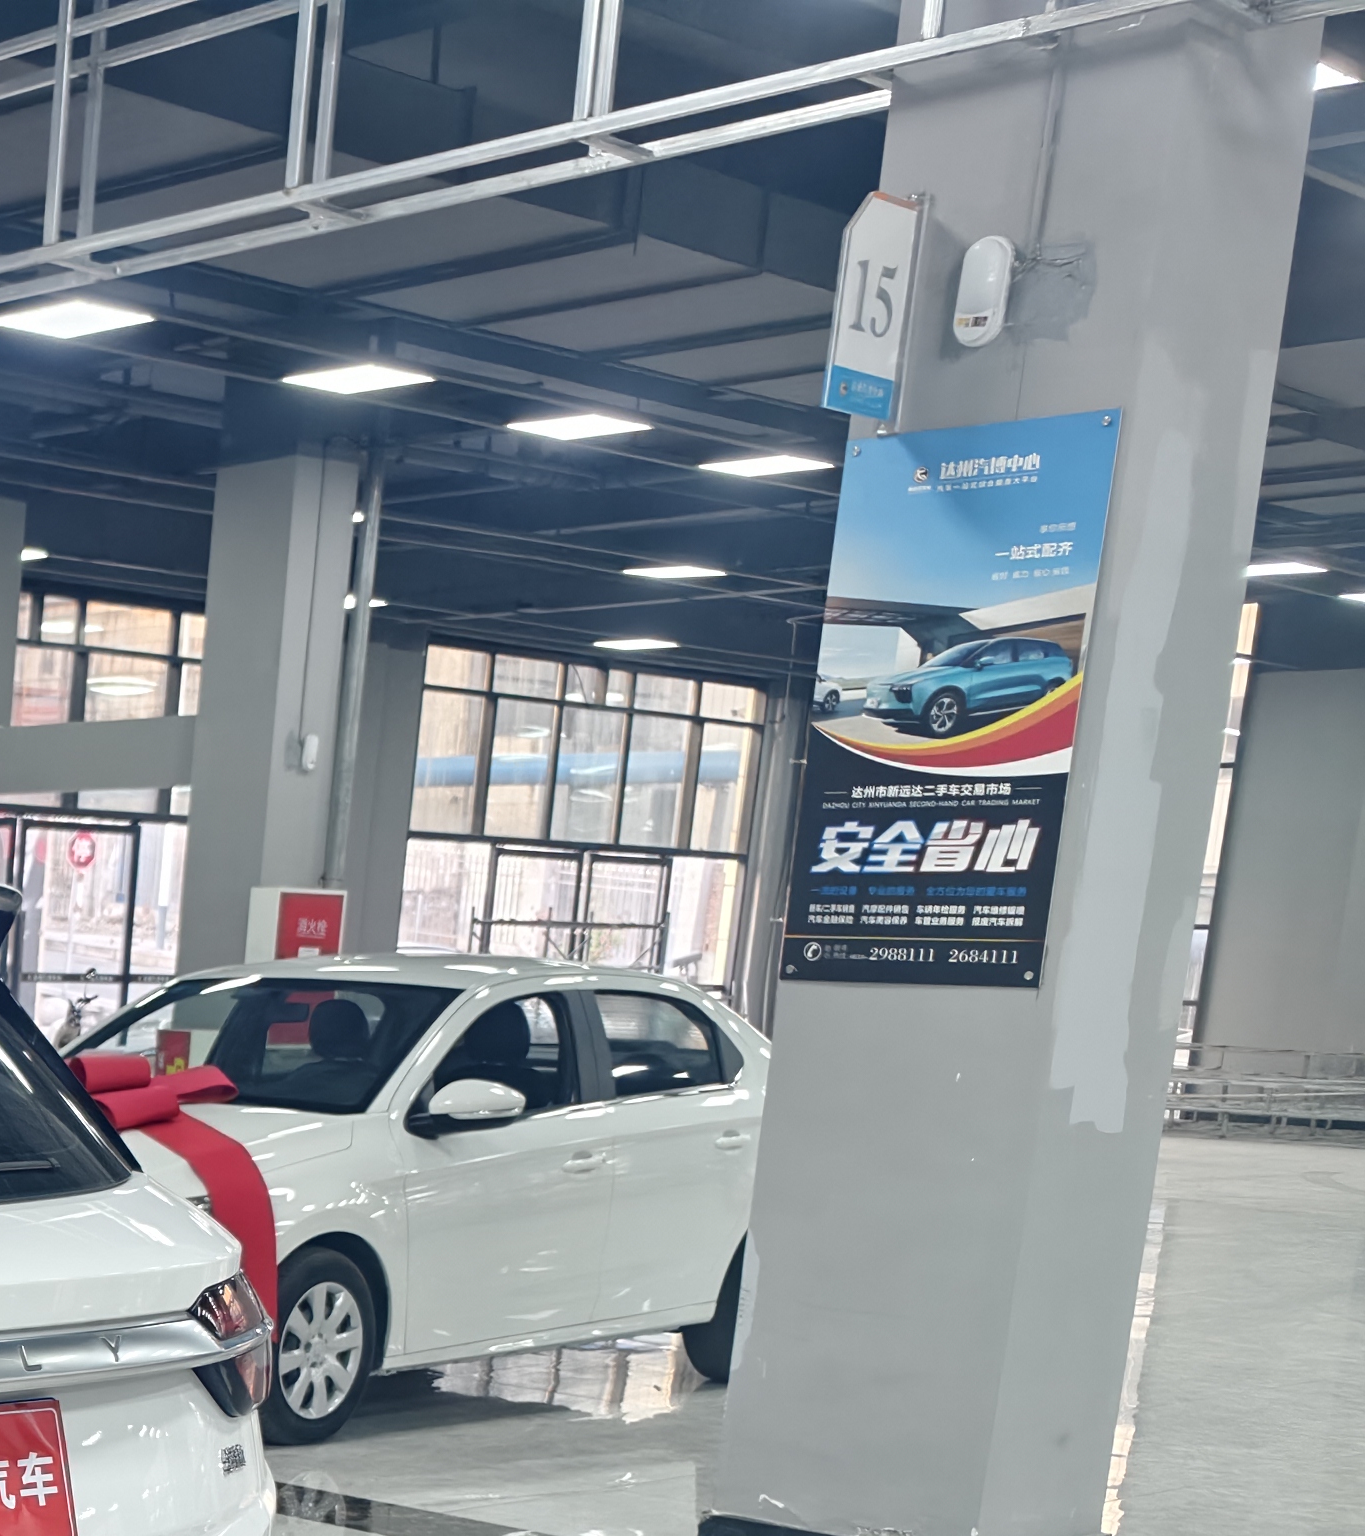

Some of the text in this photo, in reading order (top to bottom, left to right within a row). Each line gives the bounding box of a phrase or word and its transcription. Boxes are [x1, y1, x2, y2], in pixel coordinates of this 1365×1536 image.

[848, 259, 899, 338] 15
[850, 782, 1012, 799] 达州市新远达二手车交易市场
[851, 801, 866, 809] CITY
[961, 799, 976, 807] CAR
[1011, 798, 1040, 806] MARKET
[810, 818, 1041, 874] 安全省心
[868, 947, 935, 962] 2988111
[947, 948, 1019, 964] 2684111
